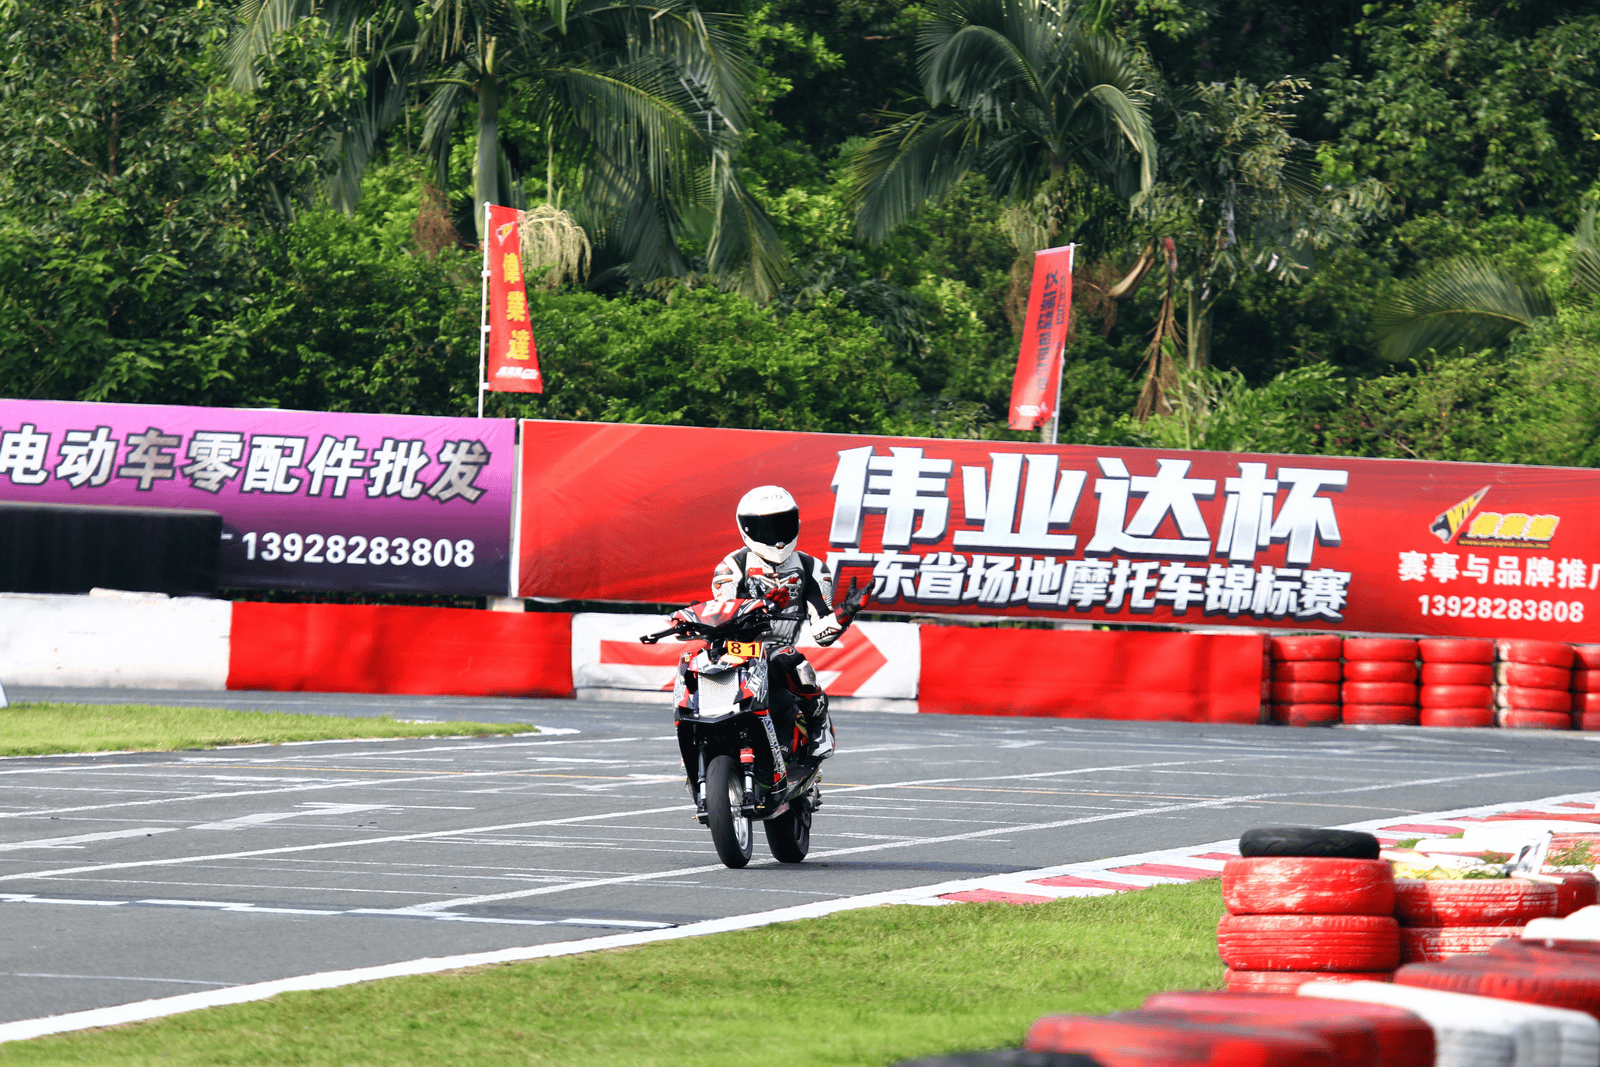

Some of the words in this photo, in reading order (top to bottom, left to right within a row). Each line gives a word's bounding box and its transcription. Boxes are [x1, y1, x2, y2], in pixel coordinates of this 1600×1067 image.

[0, 423, 490, 504] 电动车零配件批发
[829, 446, 1349, 565] 伟业达杯
[242, 531, 476, 568] 13928283808
[701, 601, 735, 617] 81
[825, 548, 1351, 622] 广东省场地摩托车锦标赛
[1418, 594, 1584, 623] 13928283808
